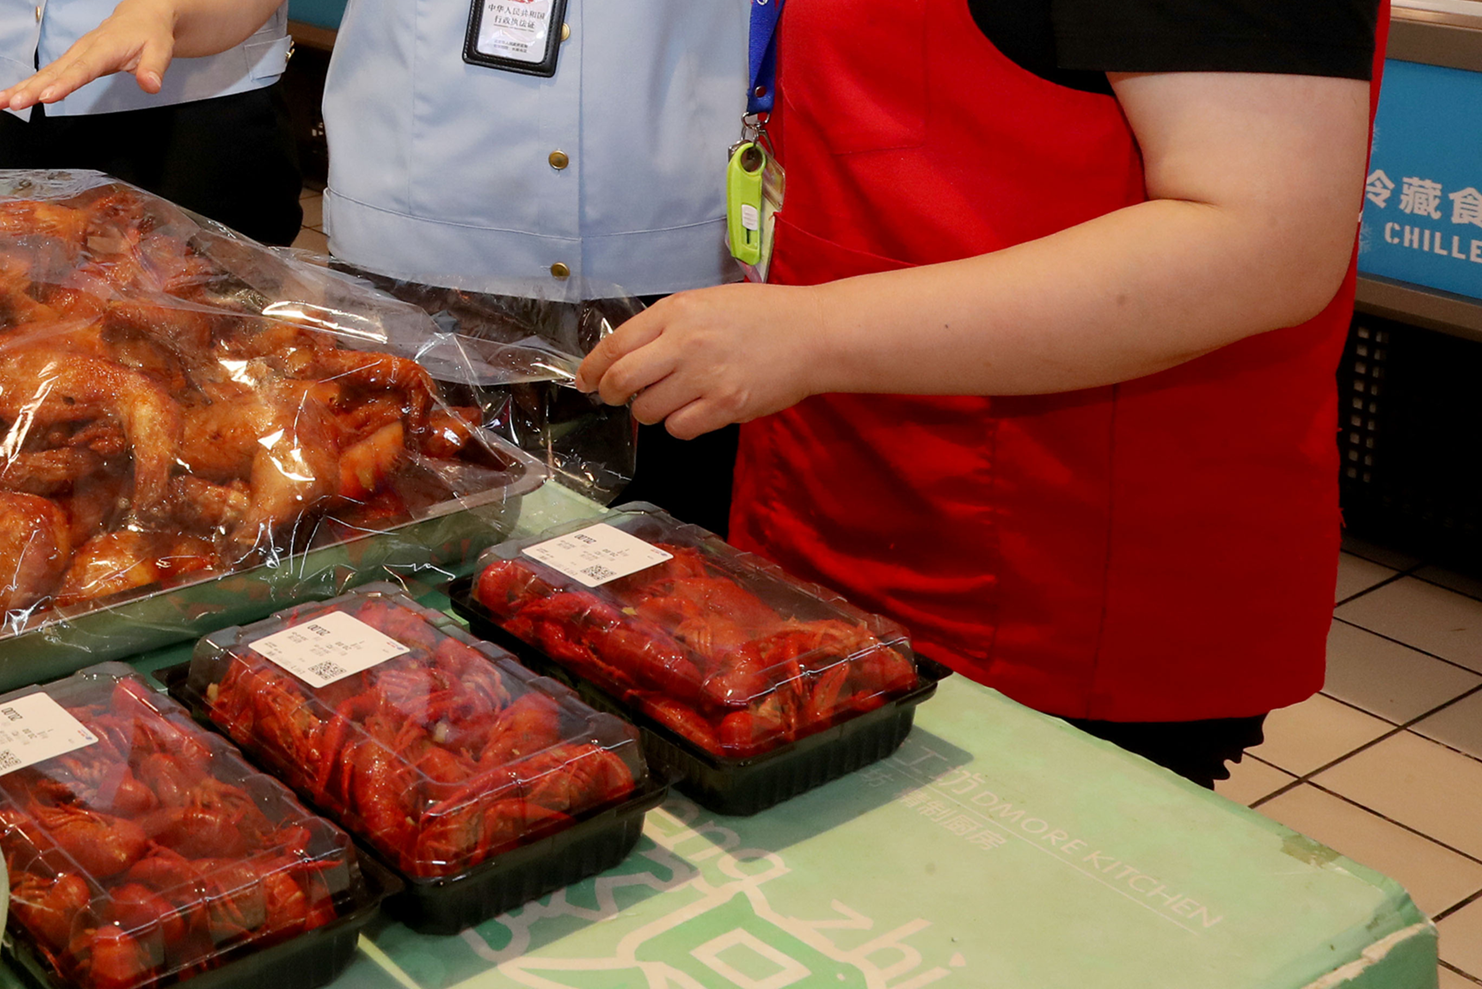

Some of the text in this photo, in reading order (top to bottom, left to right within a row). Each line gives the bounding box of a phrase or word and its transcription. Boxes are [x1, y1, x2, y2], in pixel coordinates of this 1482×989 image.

[488, 3, 546, 20] 中华人民共和国
[494, 15, 536, 30] 行政执法证
[969, 791, 1088, 856] DMORE
[1081, 849, 1224, 930] KITCHEN
